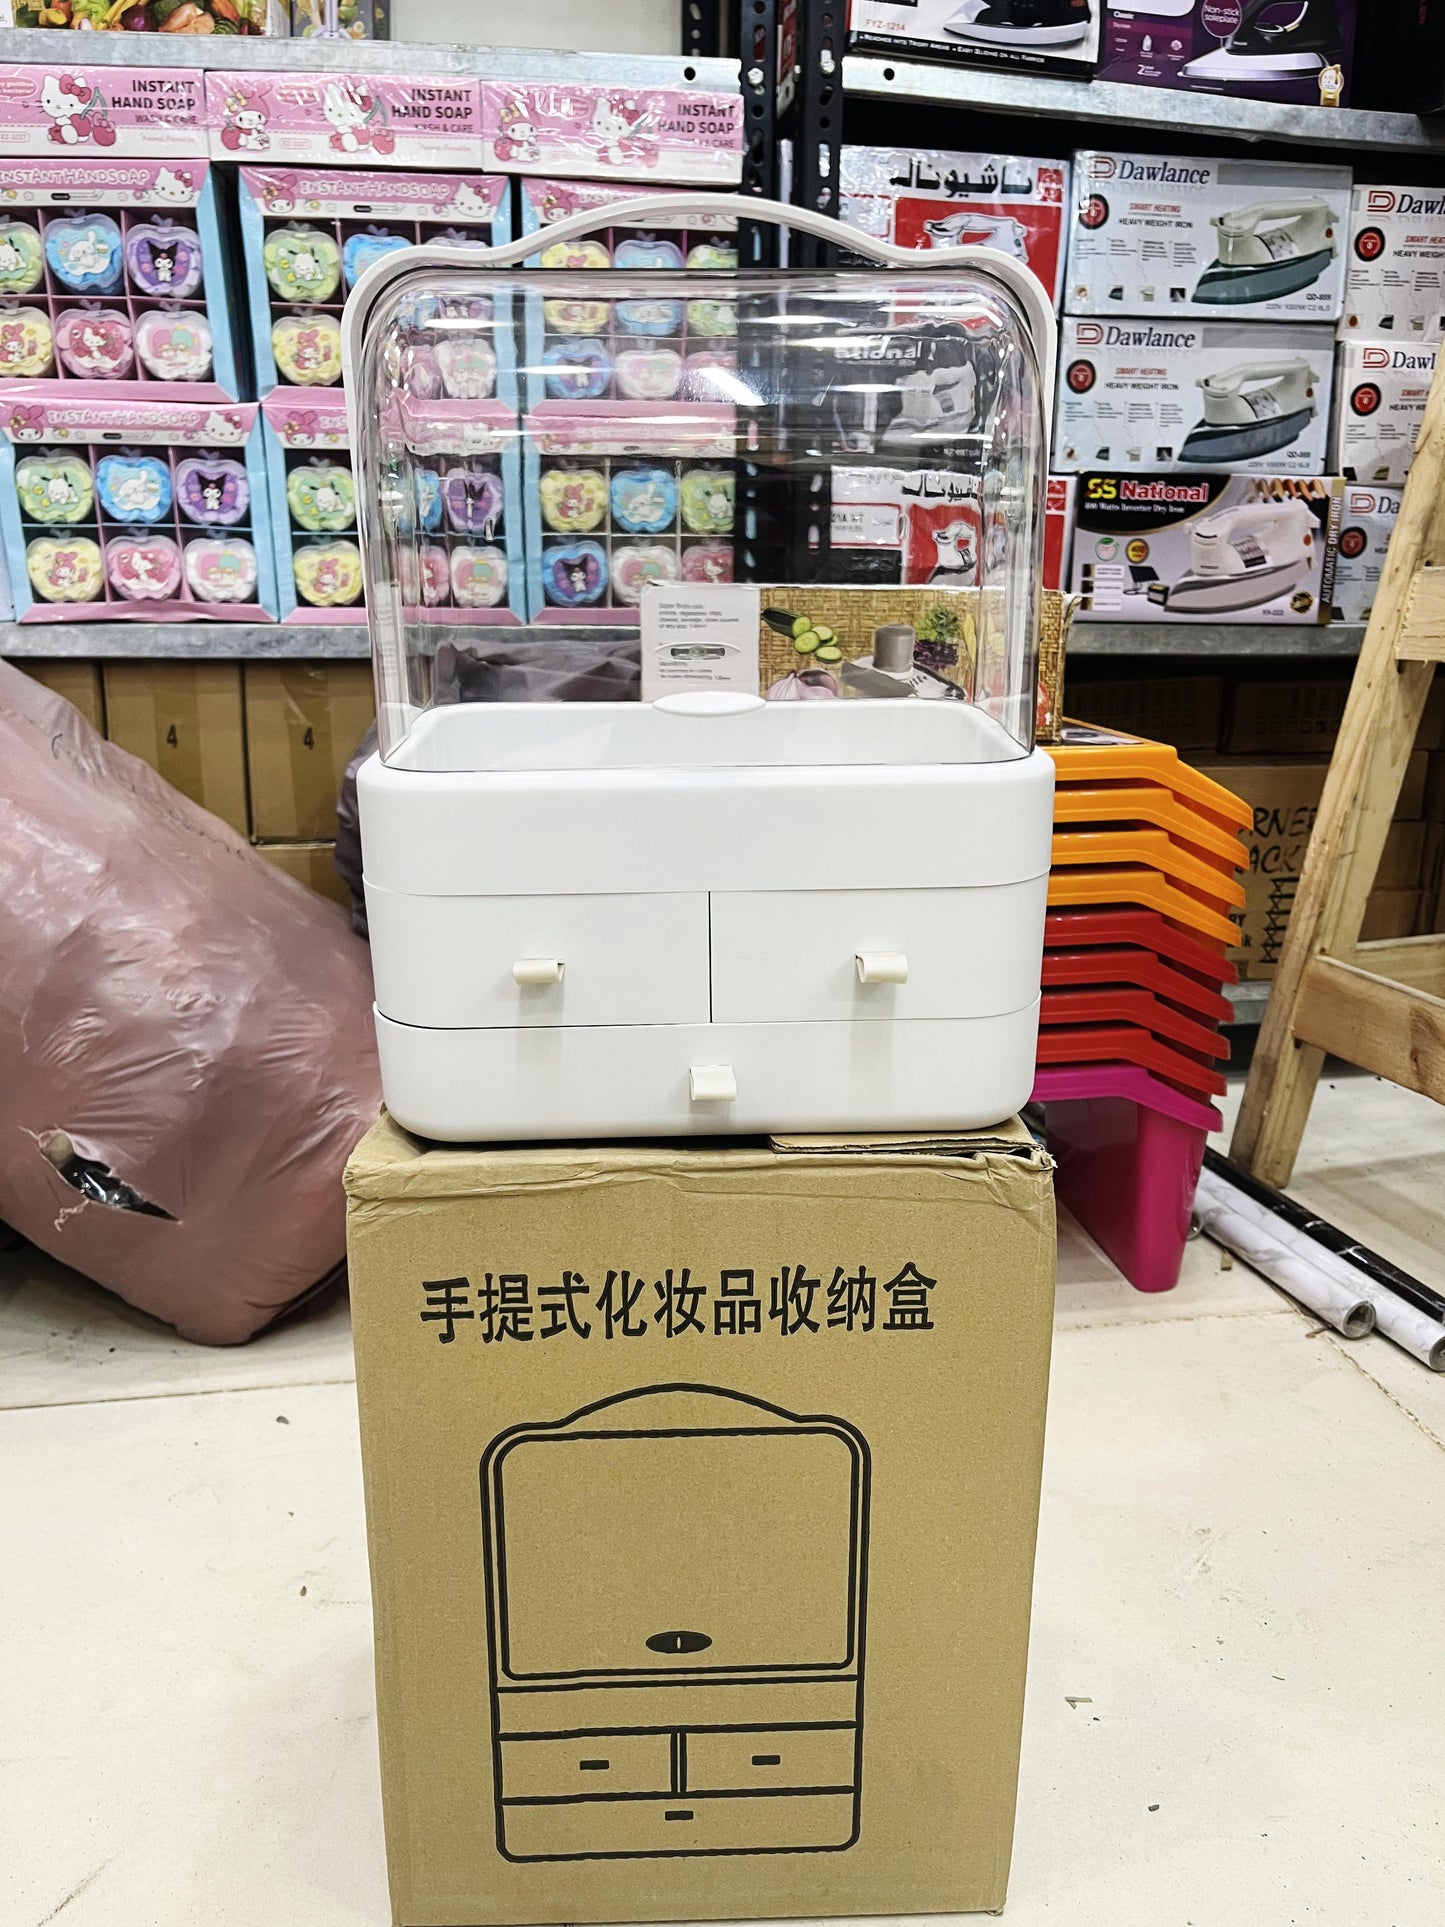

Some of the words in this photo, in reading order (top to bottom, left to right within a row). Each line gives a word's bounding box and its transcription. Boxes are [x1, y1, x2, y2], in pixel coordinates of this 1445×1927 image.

[1204, 5, 1240, 16] Non-stick
[1204, 14, 1238, 24] soleplate
[132, 80, 194, 94] INSTANT
[412, 88, 472, 102] INSTANT
[112, 96, 153, 109] HAND
[157, 98, 196, 110] SOAP
[392, 106, 432, 118] HAND
[436, 106, 473, 119] SOAP
[677, 104, 736, 118] INSTANT
[450, 124, 474, 134] CARE
[658, 120, 694, 133] HAND
[698, 122, 735, 134] SOAP
[1118, 160, 1210, 185] Dawlance
[1153, 204, 1182, 213] HEATING
[1396, 194, 1445, 215] Dawl
[1118, 218, 1142, 226] HEAVY
[1144, 219, 1173, 227] WEIGHT
[1105, 326, 1196, 348] Dawlance
[1140, 368, 1168, 376] HEATING
[1120, 480, 1210, 502] National
[1330, 496, 1342, 520] IRON
[1327, 523, 1340, 545] DRY
[1321, 546, 1338, 604] AUTOMATIC
[166, 724, 178, 748] 4
[304, 726, 314, 750] 4
[420, 1261, 938, 1344] 手提式化妆品收纳盒
